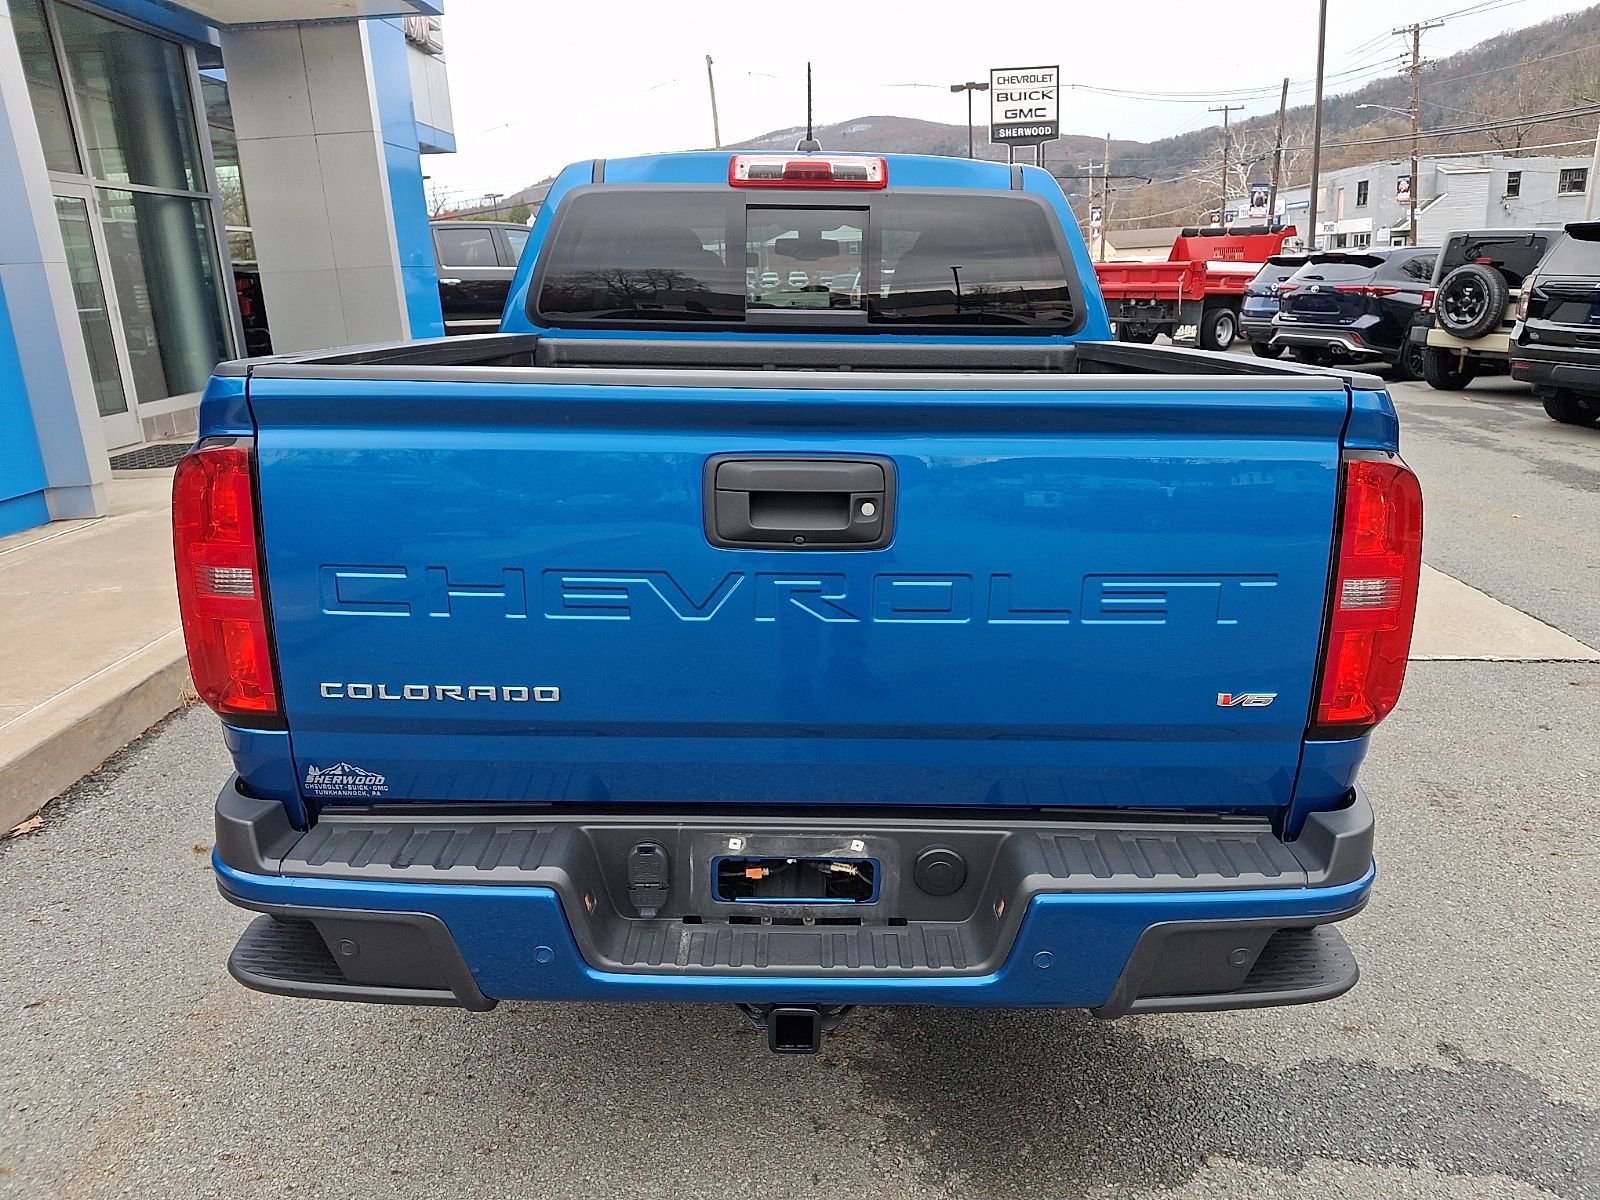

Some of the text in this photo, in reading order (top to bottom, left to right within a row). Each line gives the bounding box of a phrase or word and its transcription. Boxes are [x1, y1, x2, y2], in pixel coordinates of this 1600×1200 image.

[997, 74, 1054, 85] CHEVROLET
[996, 90, 1055, 102] BUICK
[1004, 107, 1047, 119] GMC
[998, 126, 1052, 138] SHERWOOD
[319, 563, 1279, 625] CHEVROLET
[320, 682, 560, 702] COLORADO
[1216, 692, 1278, 707] V6
[305, 774, 386, 785] SHERWOOD
